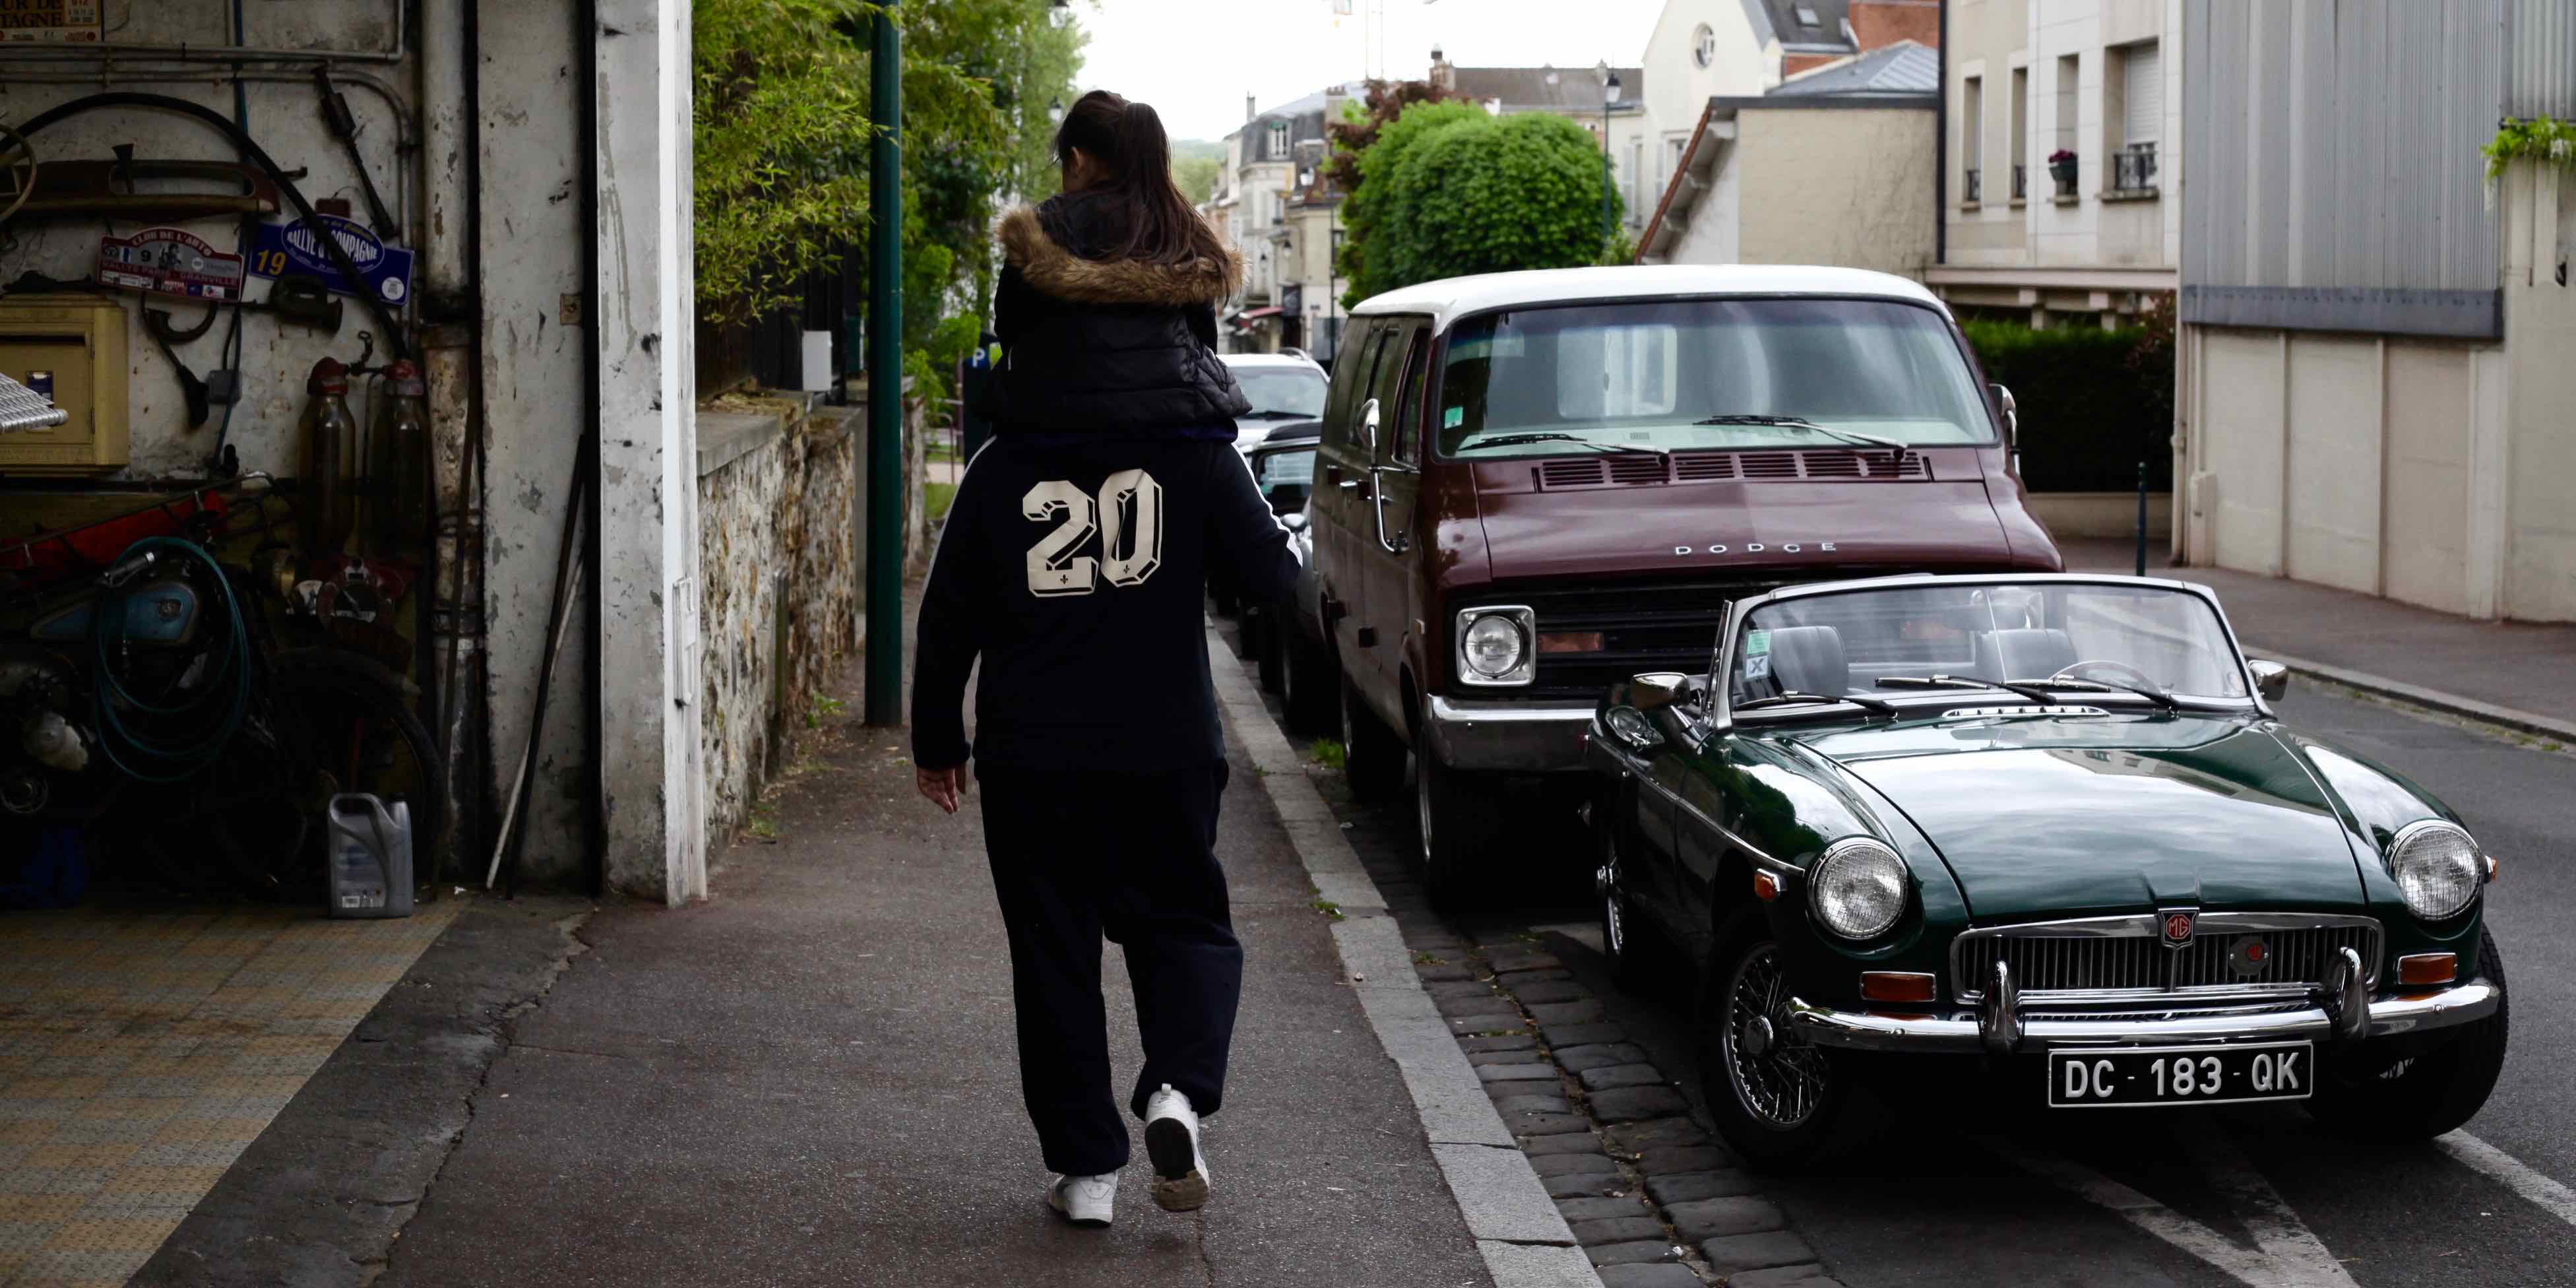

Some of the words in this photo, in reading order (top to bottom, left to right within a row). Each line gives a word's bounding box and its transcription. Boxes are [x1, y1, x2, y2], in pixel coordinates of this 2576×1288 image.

[141, 249, 152, 263] 9
[257, 248, 286, 276] 19
[972, 347, 986, 368] P
[1022, 468, 1162, 597] 20
[1676, 542, 1837, 555] DODGE
[2168, 918, 2189, 937] MG
